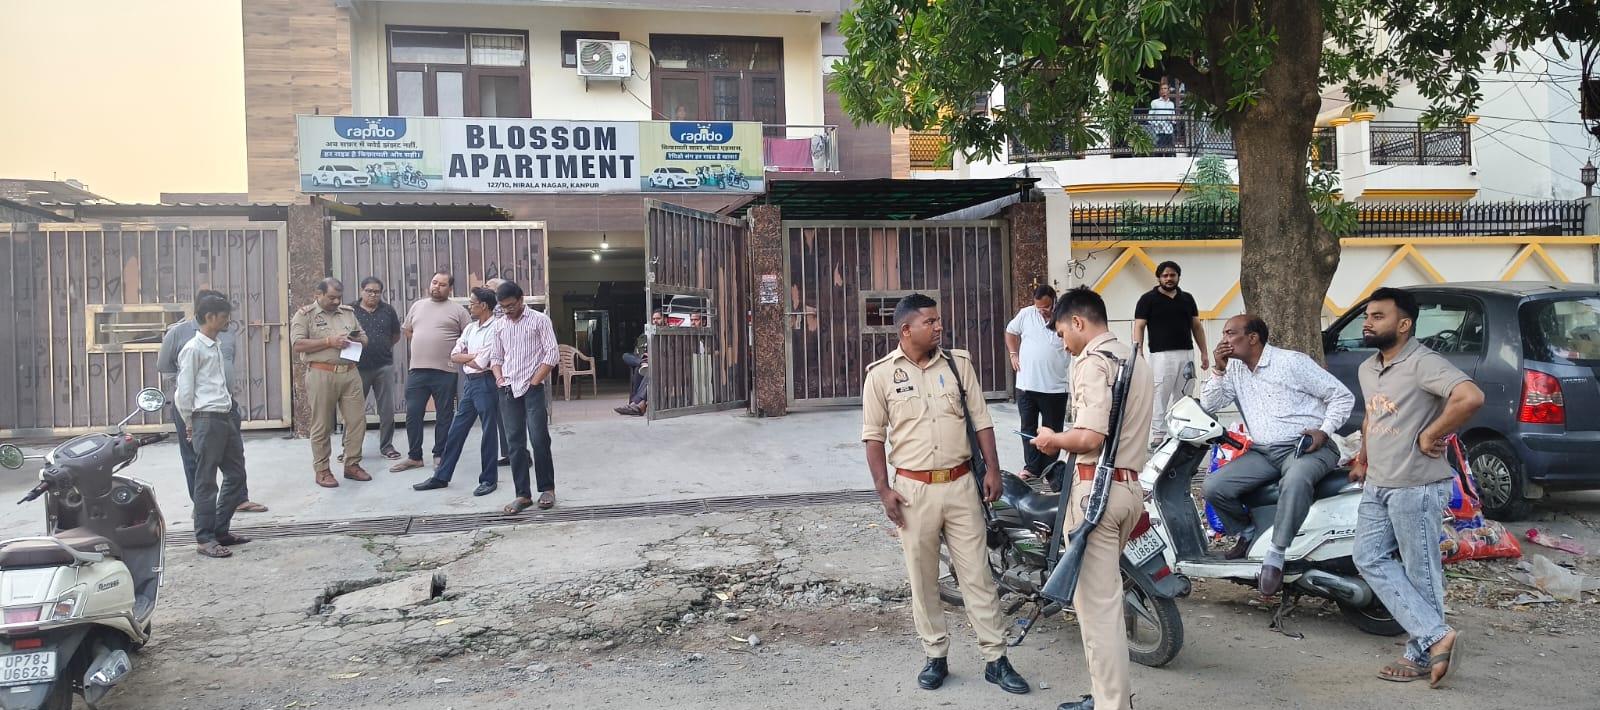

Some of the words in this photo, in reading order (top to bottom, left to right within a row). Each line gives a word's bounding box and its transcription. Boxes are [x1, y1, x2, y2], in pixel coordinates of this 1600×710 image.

[347, 126, 395, 139] rapido
[466, 124, 617, 150] BLOSSOM
[680, 131, 723, 143] rapido
[449, 153, 634, 179] APARTMENT
[5, 653, 49, 668] UP78J
[4, 665, 48, 680] U6626
